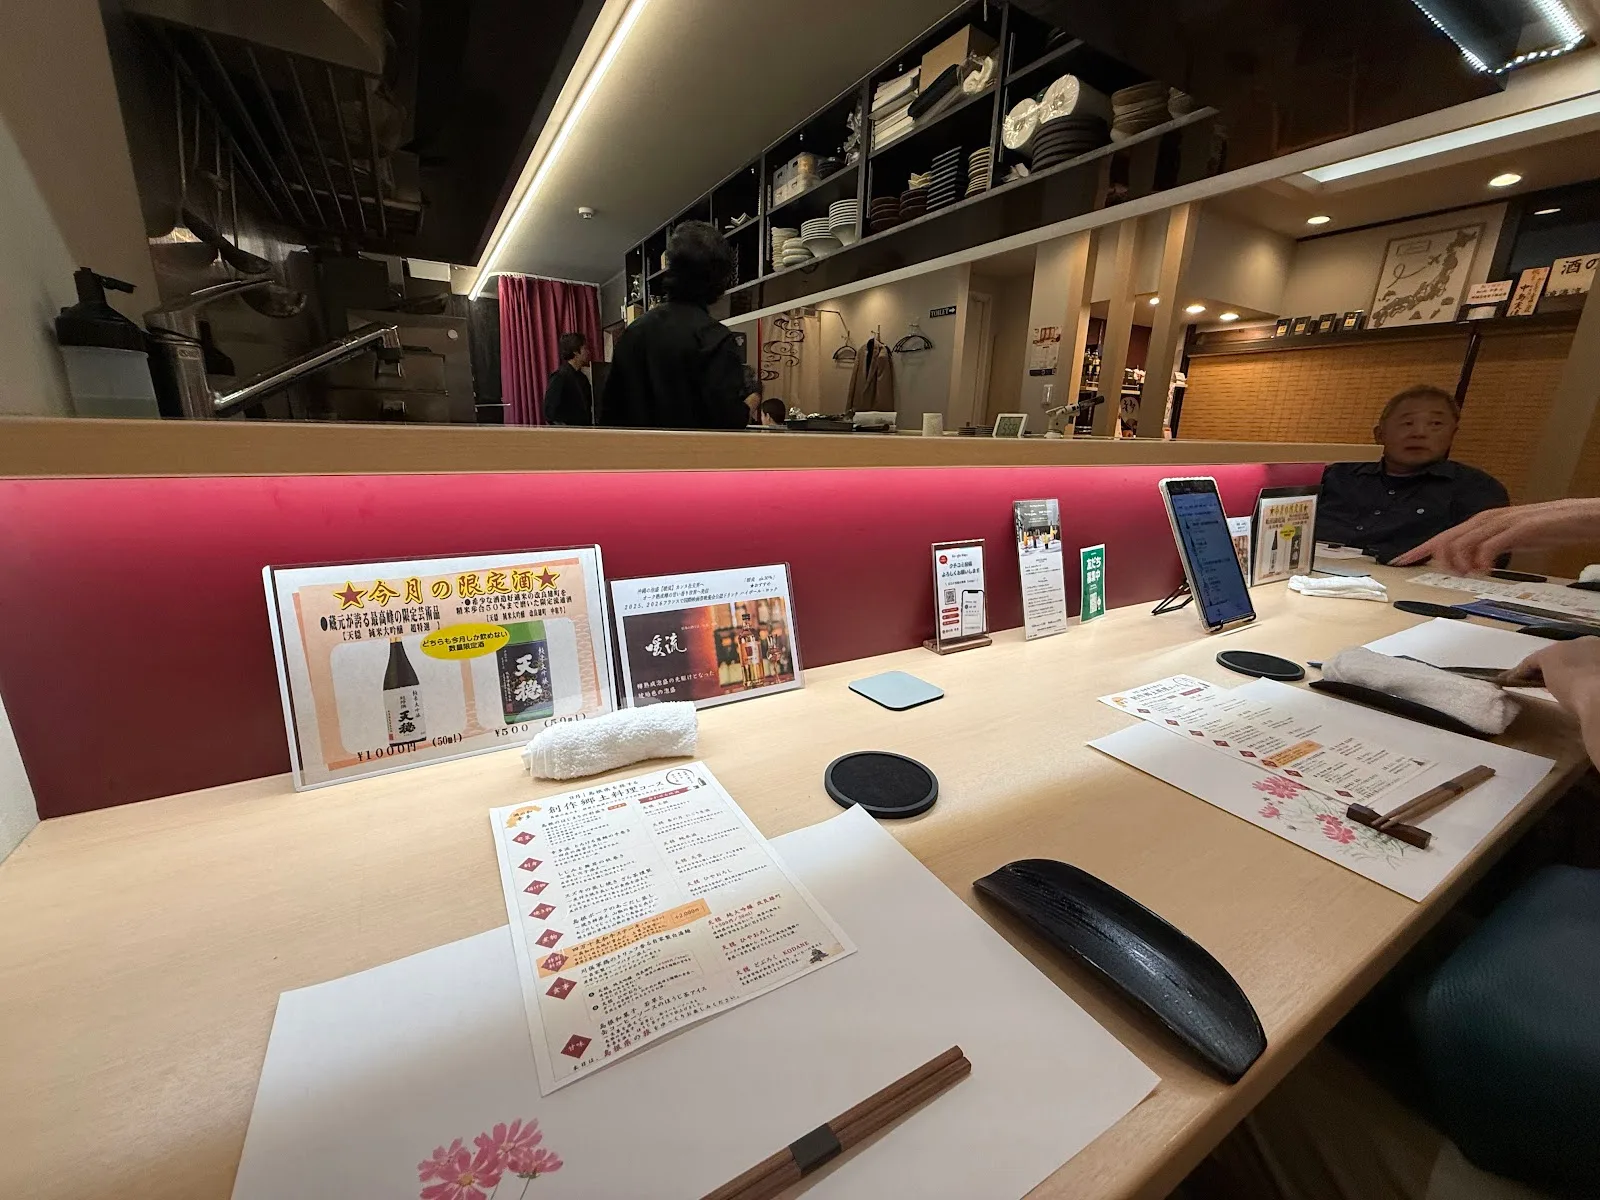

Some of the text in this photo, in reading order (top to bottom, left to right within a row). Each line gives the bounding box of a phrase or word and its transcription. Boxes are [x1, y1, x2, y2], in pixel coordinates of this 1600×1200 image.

[931, 308, 950, 318] TOILET
[942, 568, 980, 577] よろしくお願いします
[368, 568, 534, 605] 今月の限定酒
[422, 631, 508, 648] どちらも今月しか飲めない
[448, 642, 484, 652] 数量限定酒
[645, 632, 687, 656] 暖流
[546, 780, 665, 814] 創作郷土料理コース
[782, 940, 810, 955] KODANE
